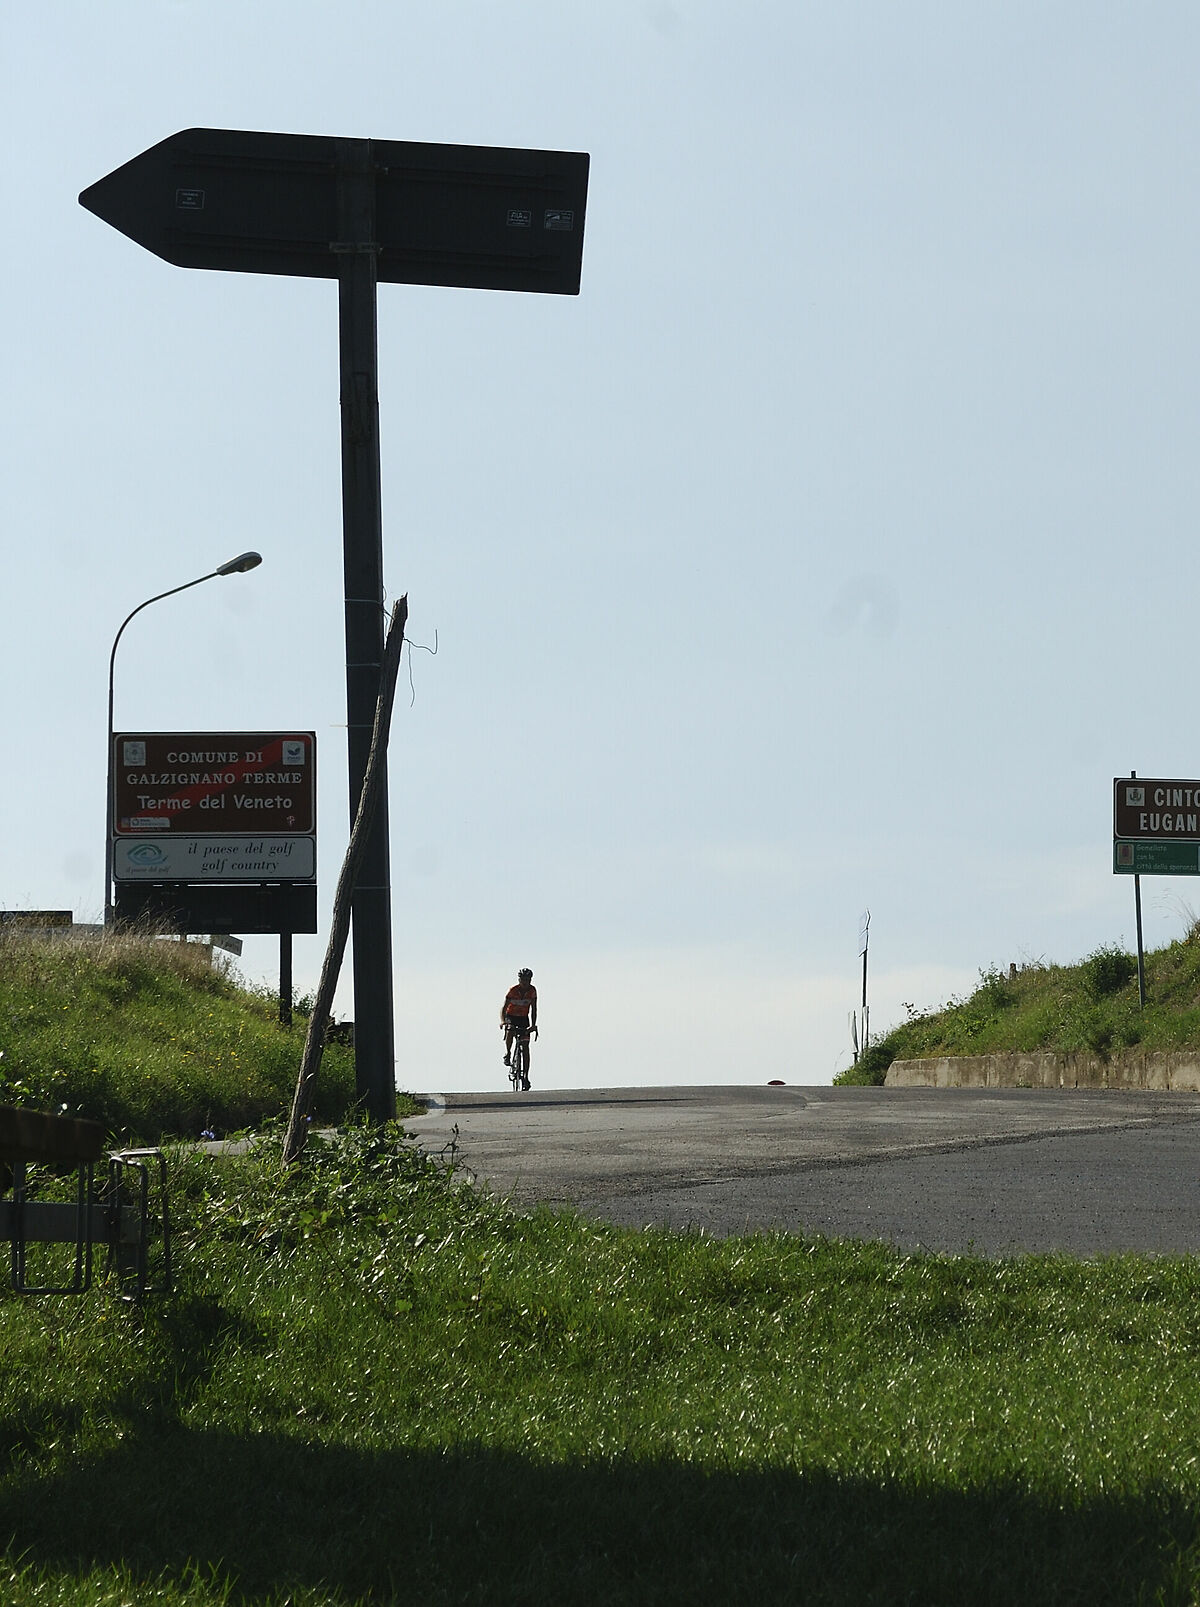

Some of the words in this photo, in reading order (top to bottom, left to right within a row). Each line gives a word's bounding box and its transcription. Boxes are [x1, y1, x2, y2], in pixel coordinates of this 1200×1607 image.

[166, 751, 239, 764] COMUNE
[244, 751, 263, 763] DI
[126, 772, 236, 786] GALZIGNANO
[242, 771, 302, 784] TERME
[136, 795, 191, 810] Terme
[200, 794, 225, 810] del
[233, 794, 293, 810] Veneto
[187, 842, 198, 855] il
[203, 845, 239, 858] paese
[245, 842, 263, 854] del
[269, 842, 296, 857] golf
[200, 858, 229, 874] golf
[231, 860, 279, 872] country
